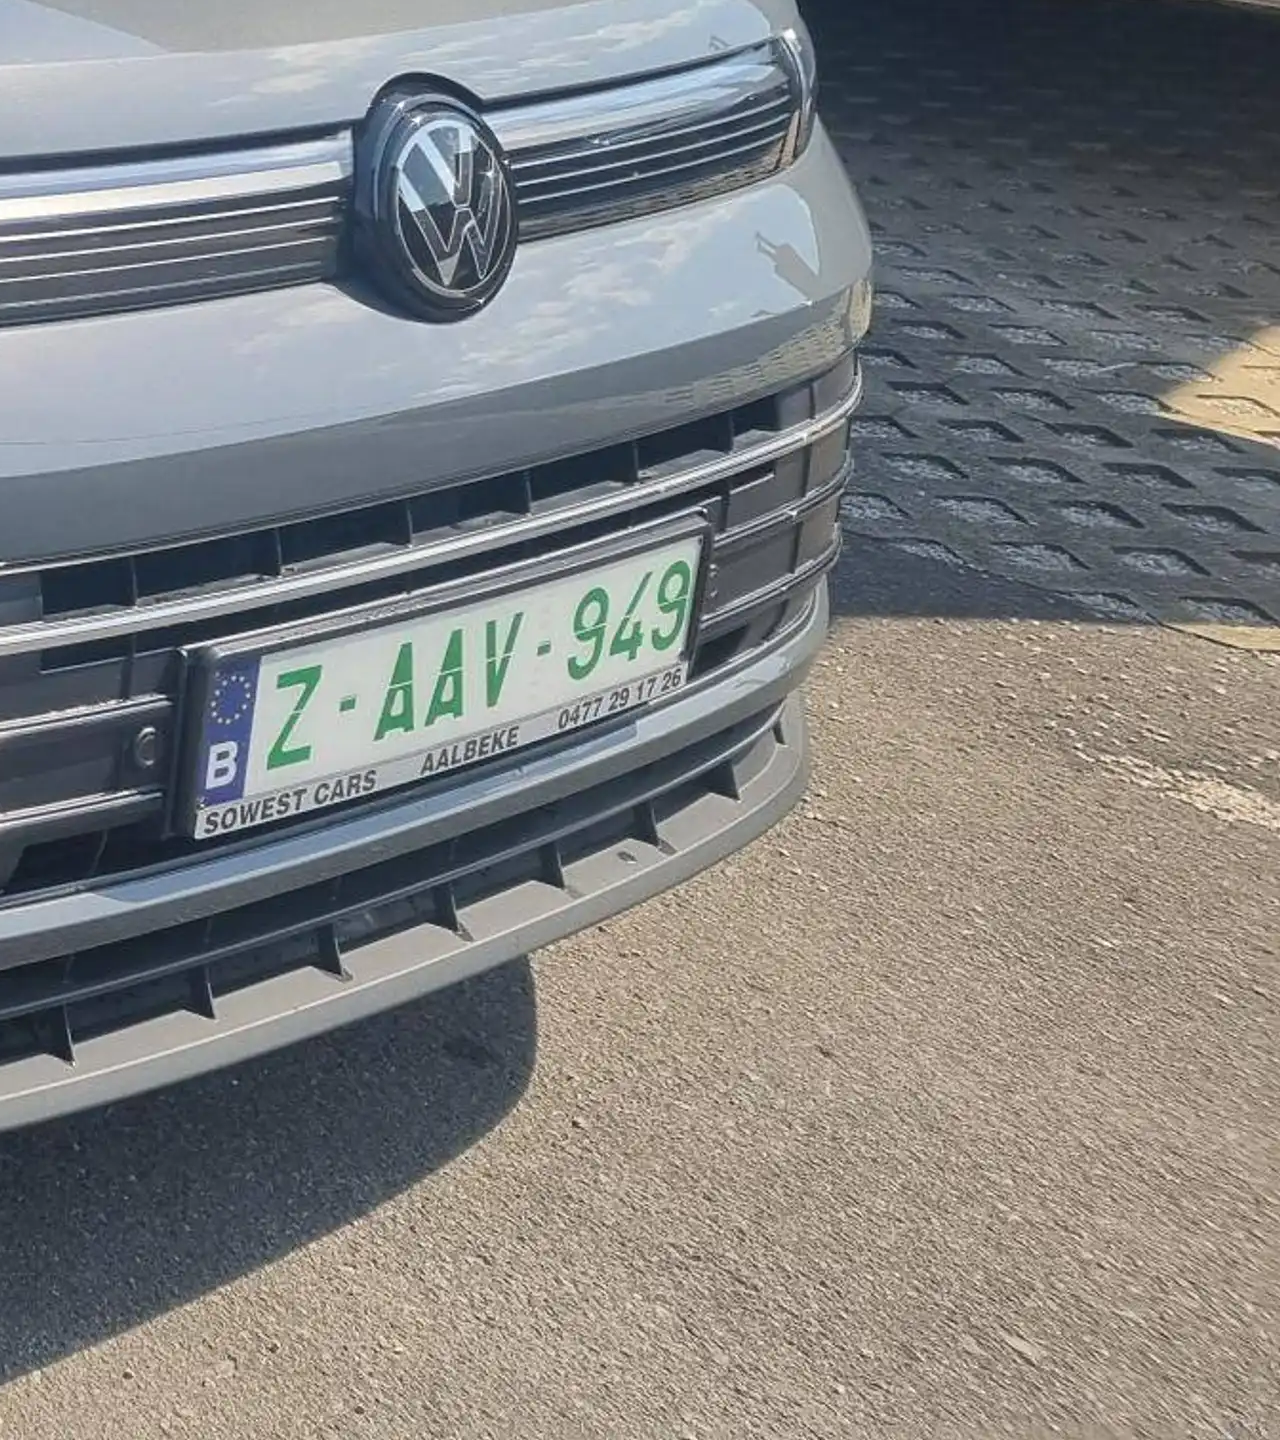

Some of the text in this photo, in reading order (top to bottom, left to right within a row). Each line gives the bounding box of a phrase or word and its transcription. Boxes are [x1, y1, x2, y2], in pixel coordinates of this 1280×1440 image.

[203, 667, 682, 834] SOWEST CARS AALBEKE 0477 29 17 26
[205, 741, 239, 790] B
